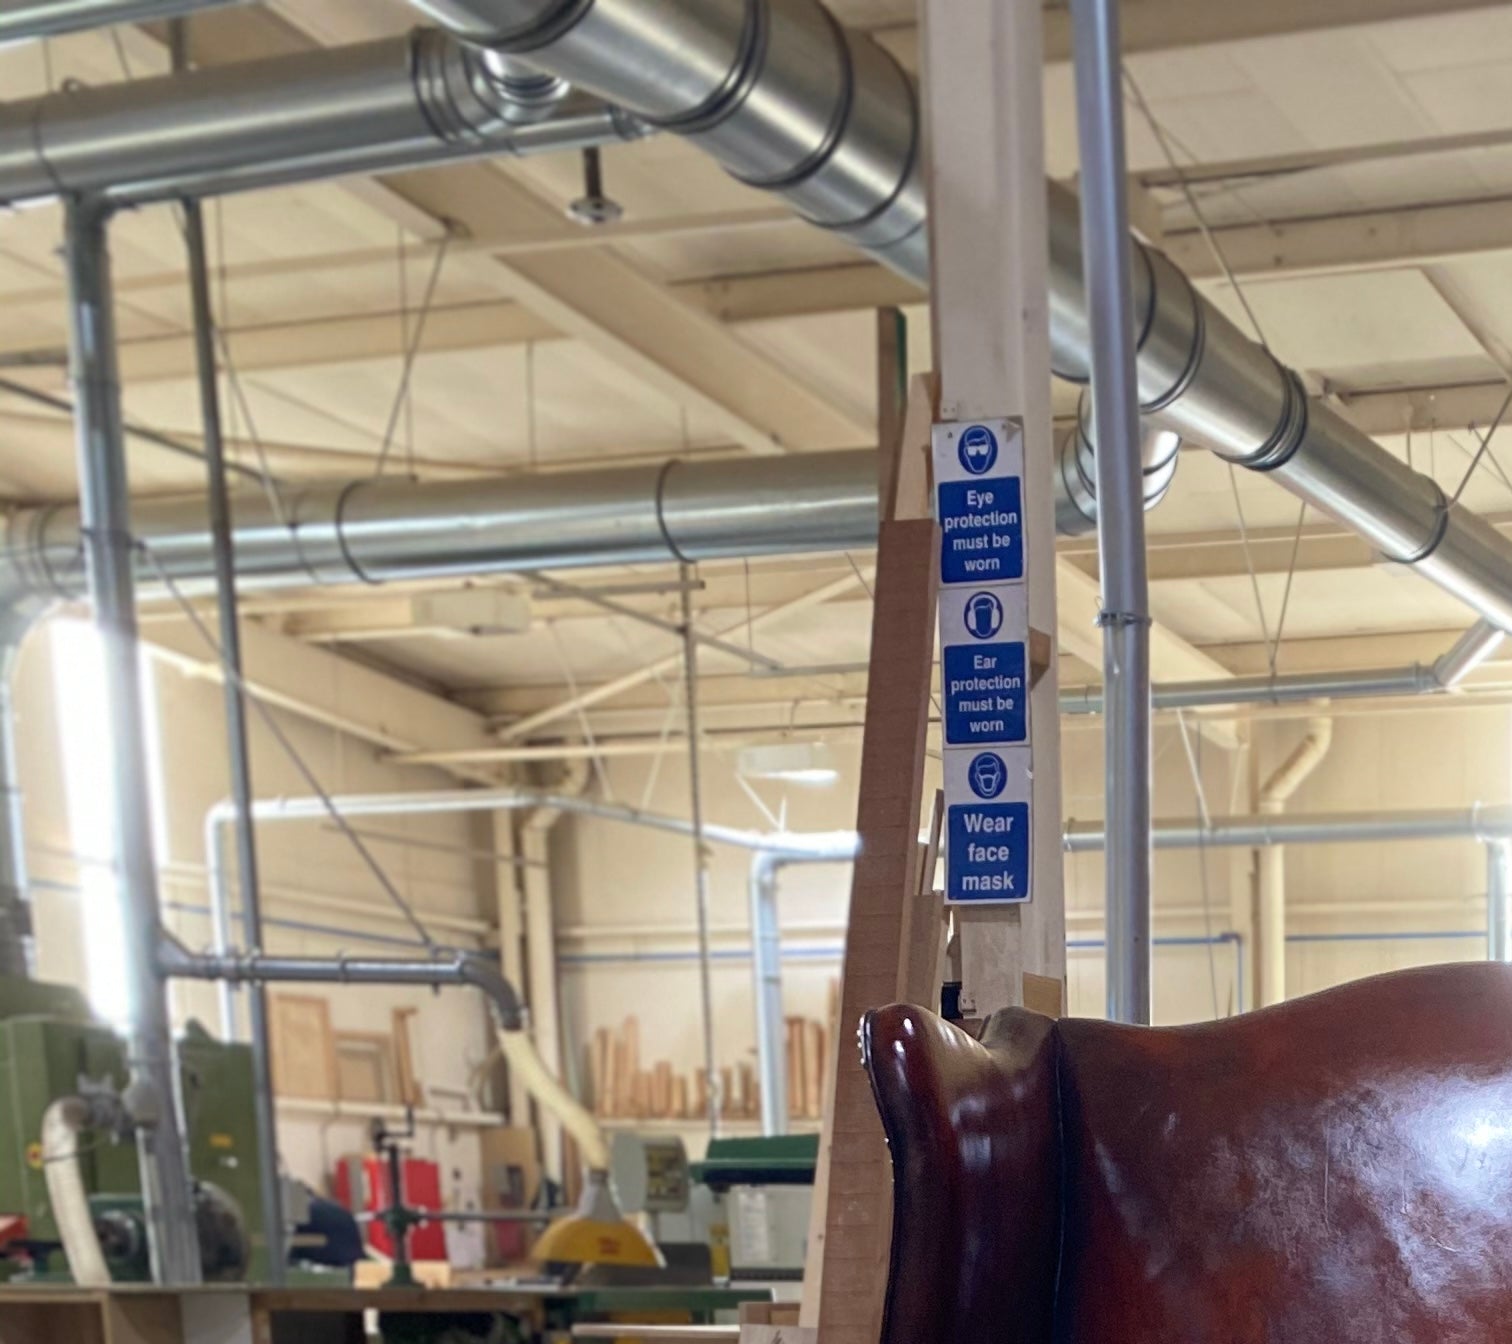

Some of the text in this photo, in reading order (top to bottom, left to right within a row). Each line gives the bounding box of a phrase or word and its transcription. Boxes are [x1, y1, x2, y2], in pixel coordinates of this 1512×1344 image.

[967, 490, 994, 509] Eye
[944, 511, 1018, 533] protection
[953, 532, 1011, 551] must be
[964, 557, 1001, 572] worn
[973, 655, 998, 670] Ear
[950, 675, 1021, 696] protection
[959, 696, 1014, 713] must be
[969, 719, 1005, 733] worn
[963, 813, 1014, 833] Wear
[967, 843, 1010, 862] face
[962, 870, 1015, 891] mask
